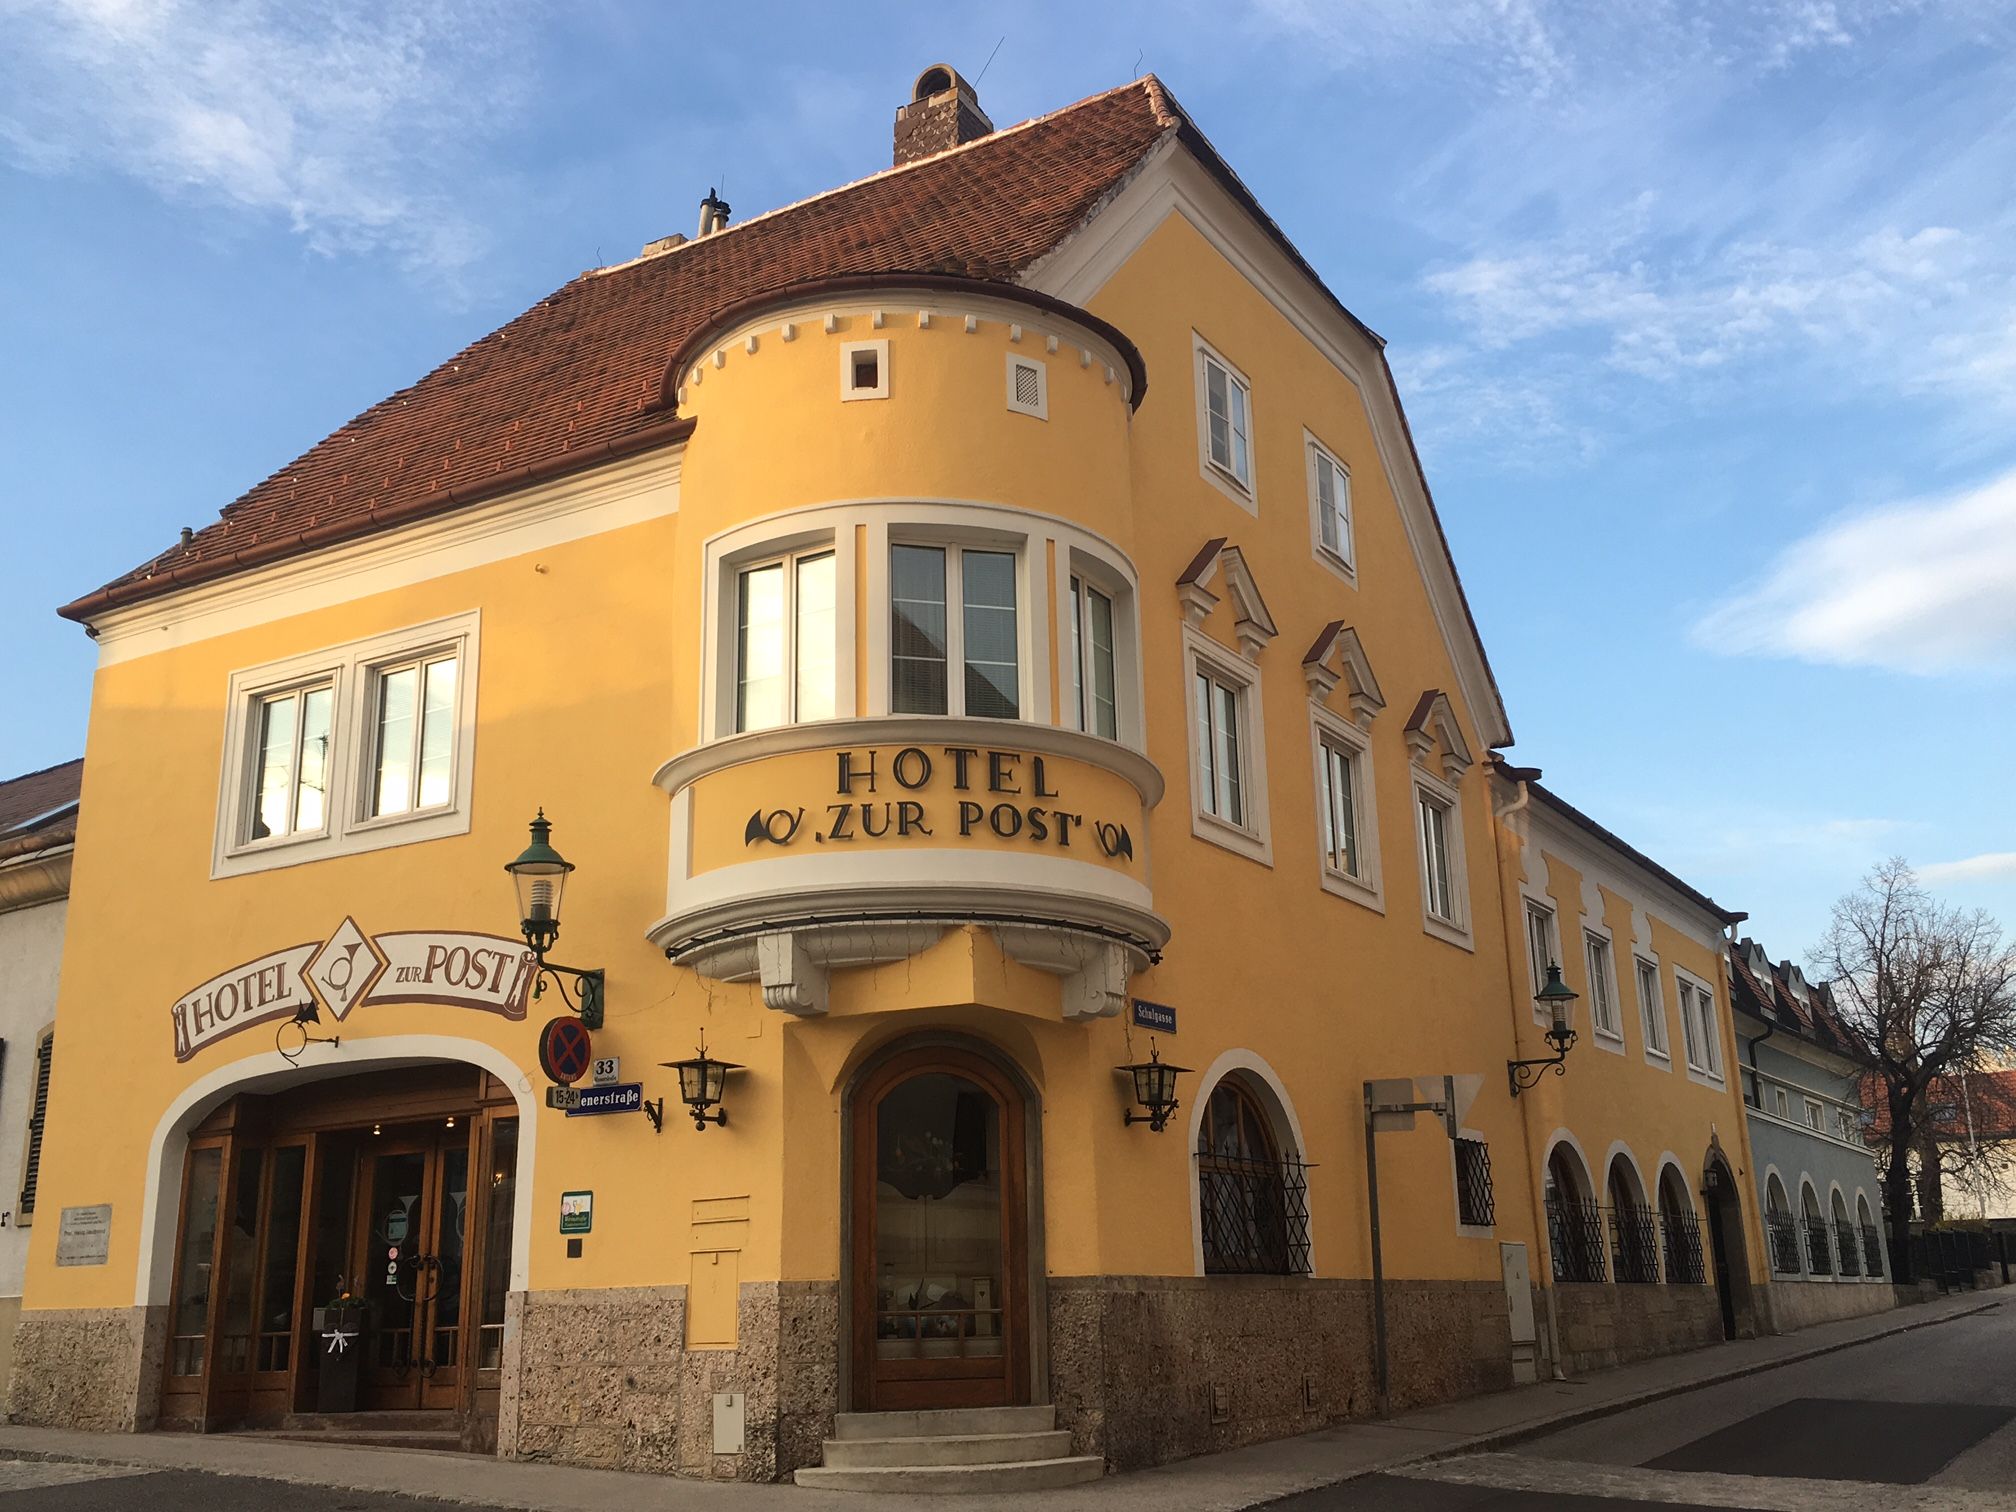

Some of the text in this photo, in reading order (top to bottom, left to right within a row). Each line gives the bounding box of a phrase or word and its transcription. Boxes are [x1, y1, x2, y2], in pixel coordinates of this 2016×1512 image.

[836, 747, 1059, 798] HOTEL
[191, 944, 515, 1037] HOTEL ZUR POST
[1137, 1004, 1173, 1025] Schulgasse
[596, 1059, 614, 1075] 33
[581, 1089, 639, 1106] enerstraße
